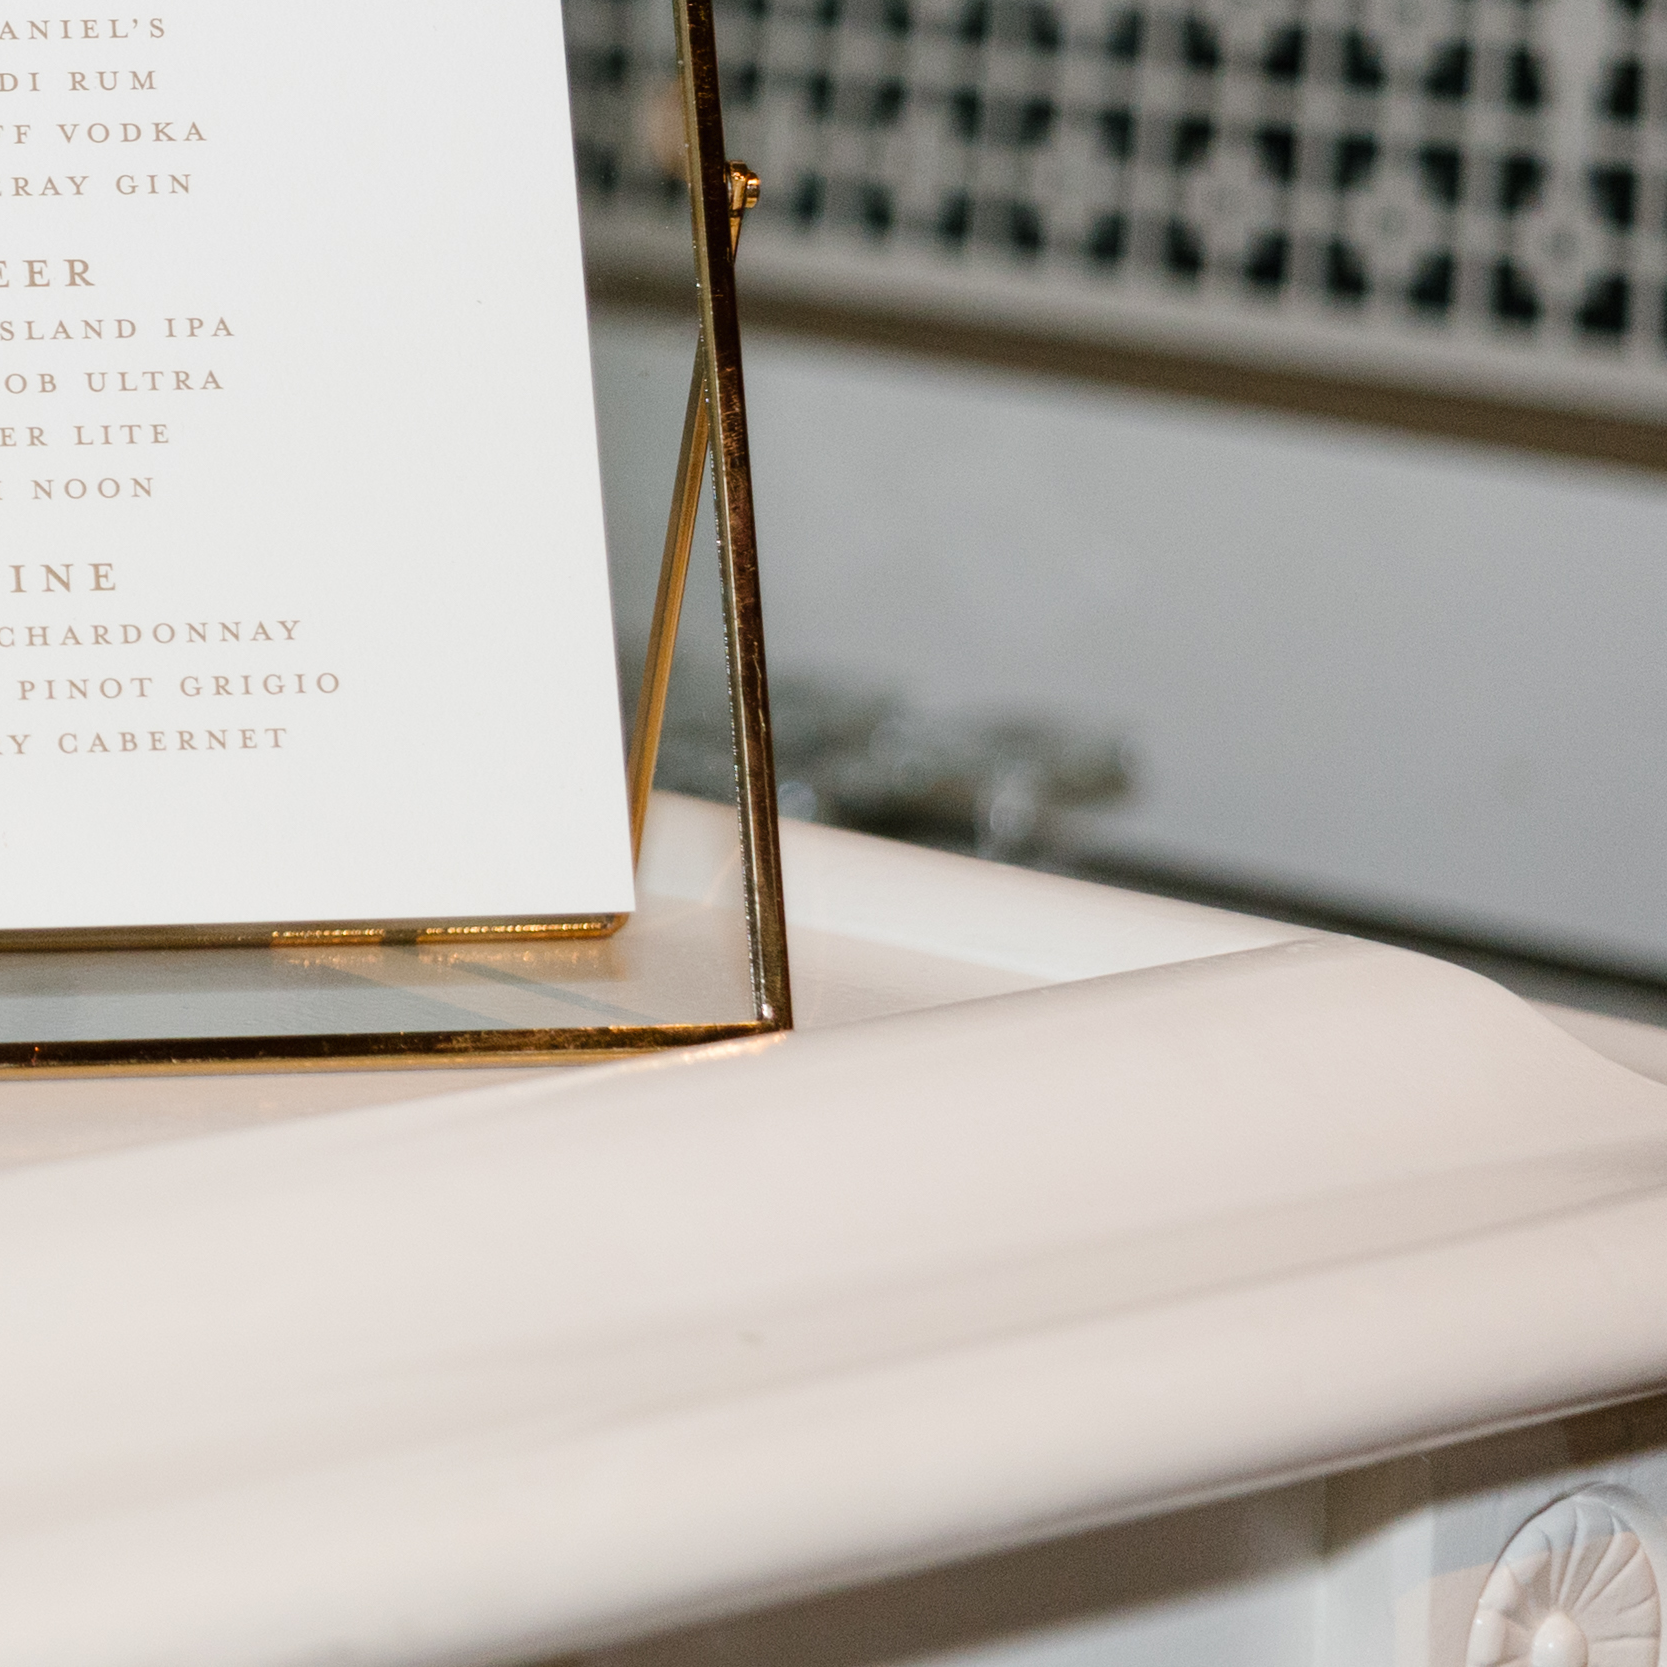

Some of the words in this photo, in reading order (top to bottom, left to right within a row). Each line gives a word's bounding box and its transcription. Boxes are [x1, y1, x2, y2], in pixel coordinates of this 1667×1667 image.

[67, 70, 156, 91] RUM
[56, 121, 207, 144] VODKA
[115, 173, 191, 196] GIN
[164, 316, 235, 338] IPA
[84, 369, 224, 393] ULTRA
[73, 423, 169, 446] LITE
[31, 477, 153, 500] NOON
[18, 677, 153, 701] PINOT
[179, 672, 340, 698] GRIGIO
[57, 727, 287, 754] CABERNET
